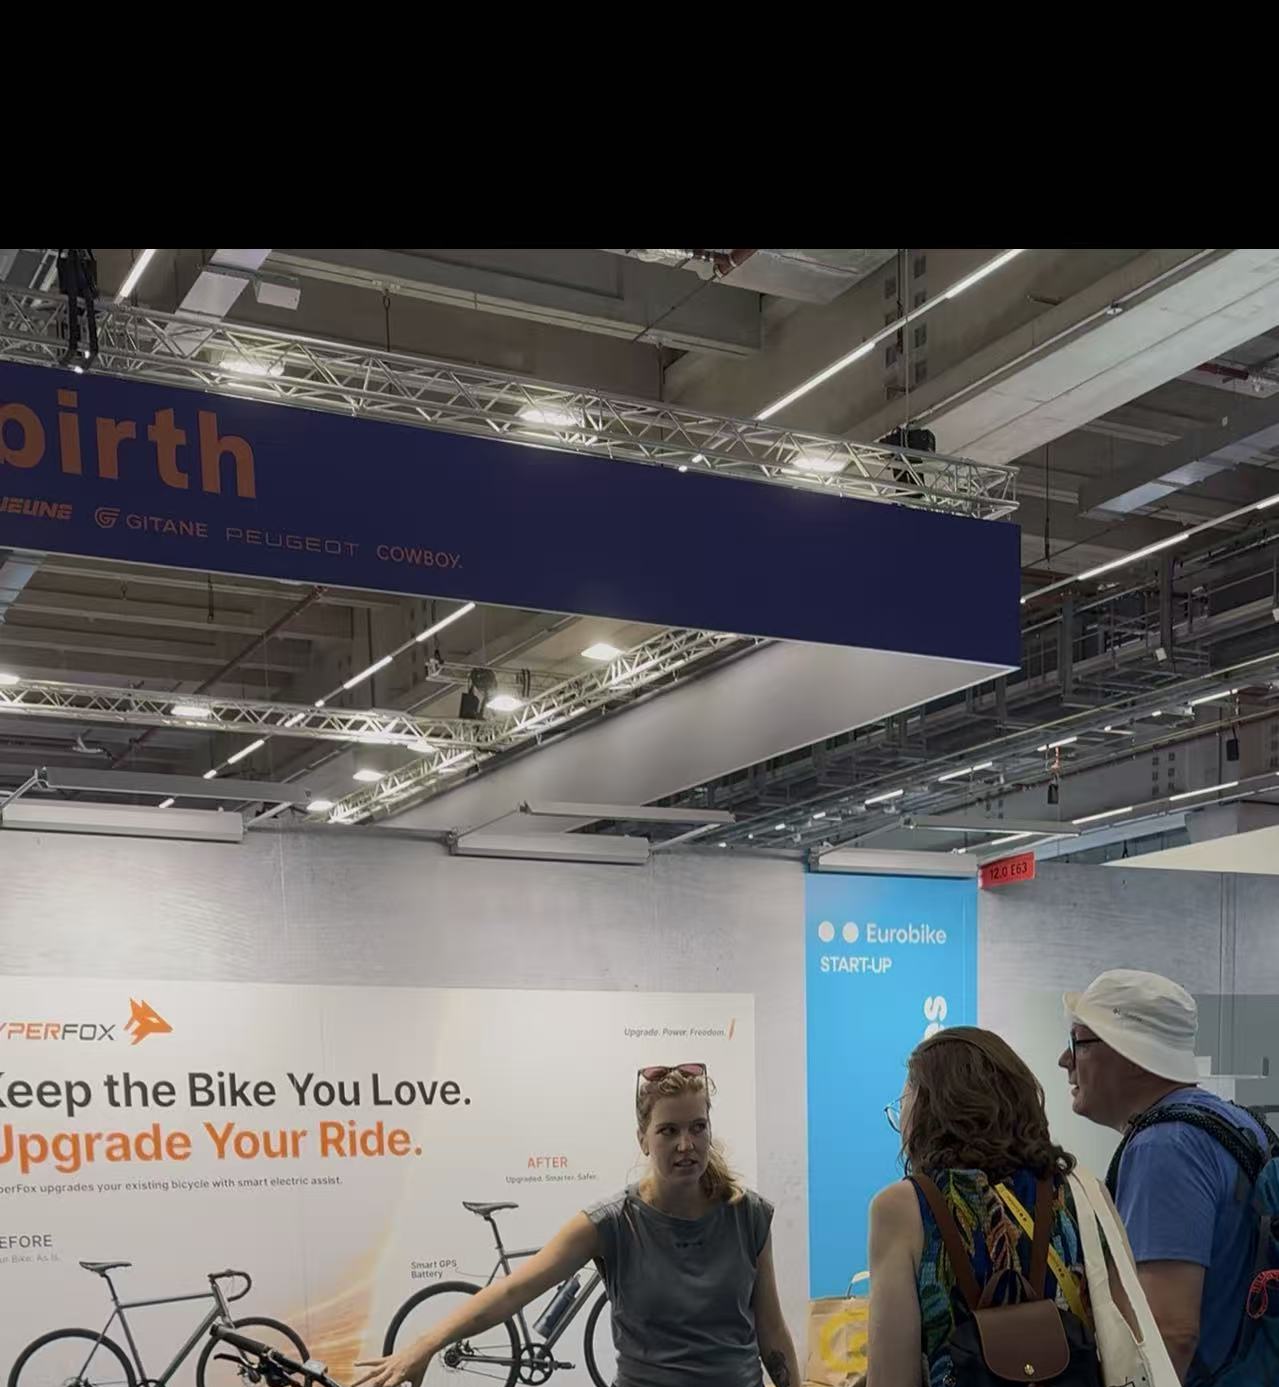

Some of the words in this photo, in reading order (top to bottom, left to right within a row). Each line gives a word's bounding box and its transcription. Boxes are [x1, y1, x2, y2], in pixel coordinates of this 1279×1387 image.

[126, 514, 209, 538] GITANE
[226, 527, 359, 557] PEUGEOT
[376, 545, 463, 569] COWBOY.
[1010, 861, 1028, 876] E63
[866, 922, 947, 945] Eurobike
[820, 956, 892, 974] START-UP
[103, 1072, 176, 1107] the
[189, 1071, 276, 1107] Bike
[287, 1072, 361, 1106] You
[372, 1072, 471, 1106] Love.
[203, 1121, 307, 1160] Your
[319, 1120, 423, 1159] Ride.
[527, 1156, 568, 1169] AFTER
[40, 1183, 94, 1195] upgrades
[97, 1183, 122, 1193] your
[125, 1179, 169, 1191] existing
[171, 1178, 210, 1190] bicycle
[212, 1178, 235, 1189] with
[237, 1177, 268, 1188] smart
[270, 1176, 308, 1186] electric
[311, 1175, 343, 1185] assist.
[410, 1261, 437, 1270] Smart
[439, 1259, 457, 1268] GPS
[411, 1271, 443, 1279] Battery
